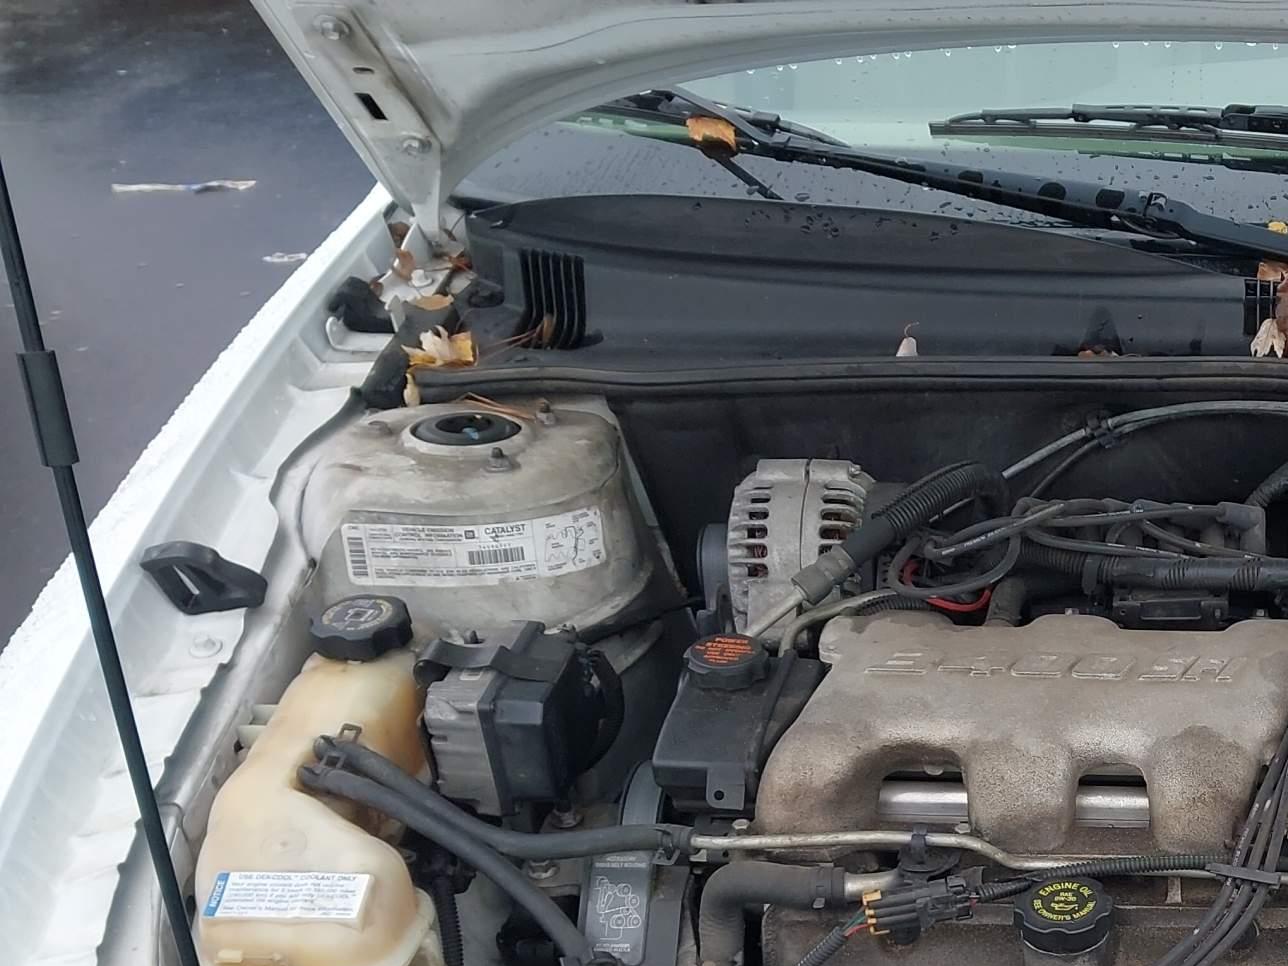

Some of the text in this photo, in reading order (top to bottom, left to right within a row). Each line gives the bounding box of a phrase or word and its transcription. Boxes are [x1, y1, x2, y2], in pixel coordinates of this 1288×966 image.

[484, 523, 526, 535] CATALYST
[208, 879, 226, 907] NOTICE
[1038, 882, 1080, 896] ENGINE
